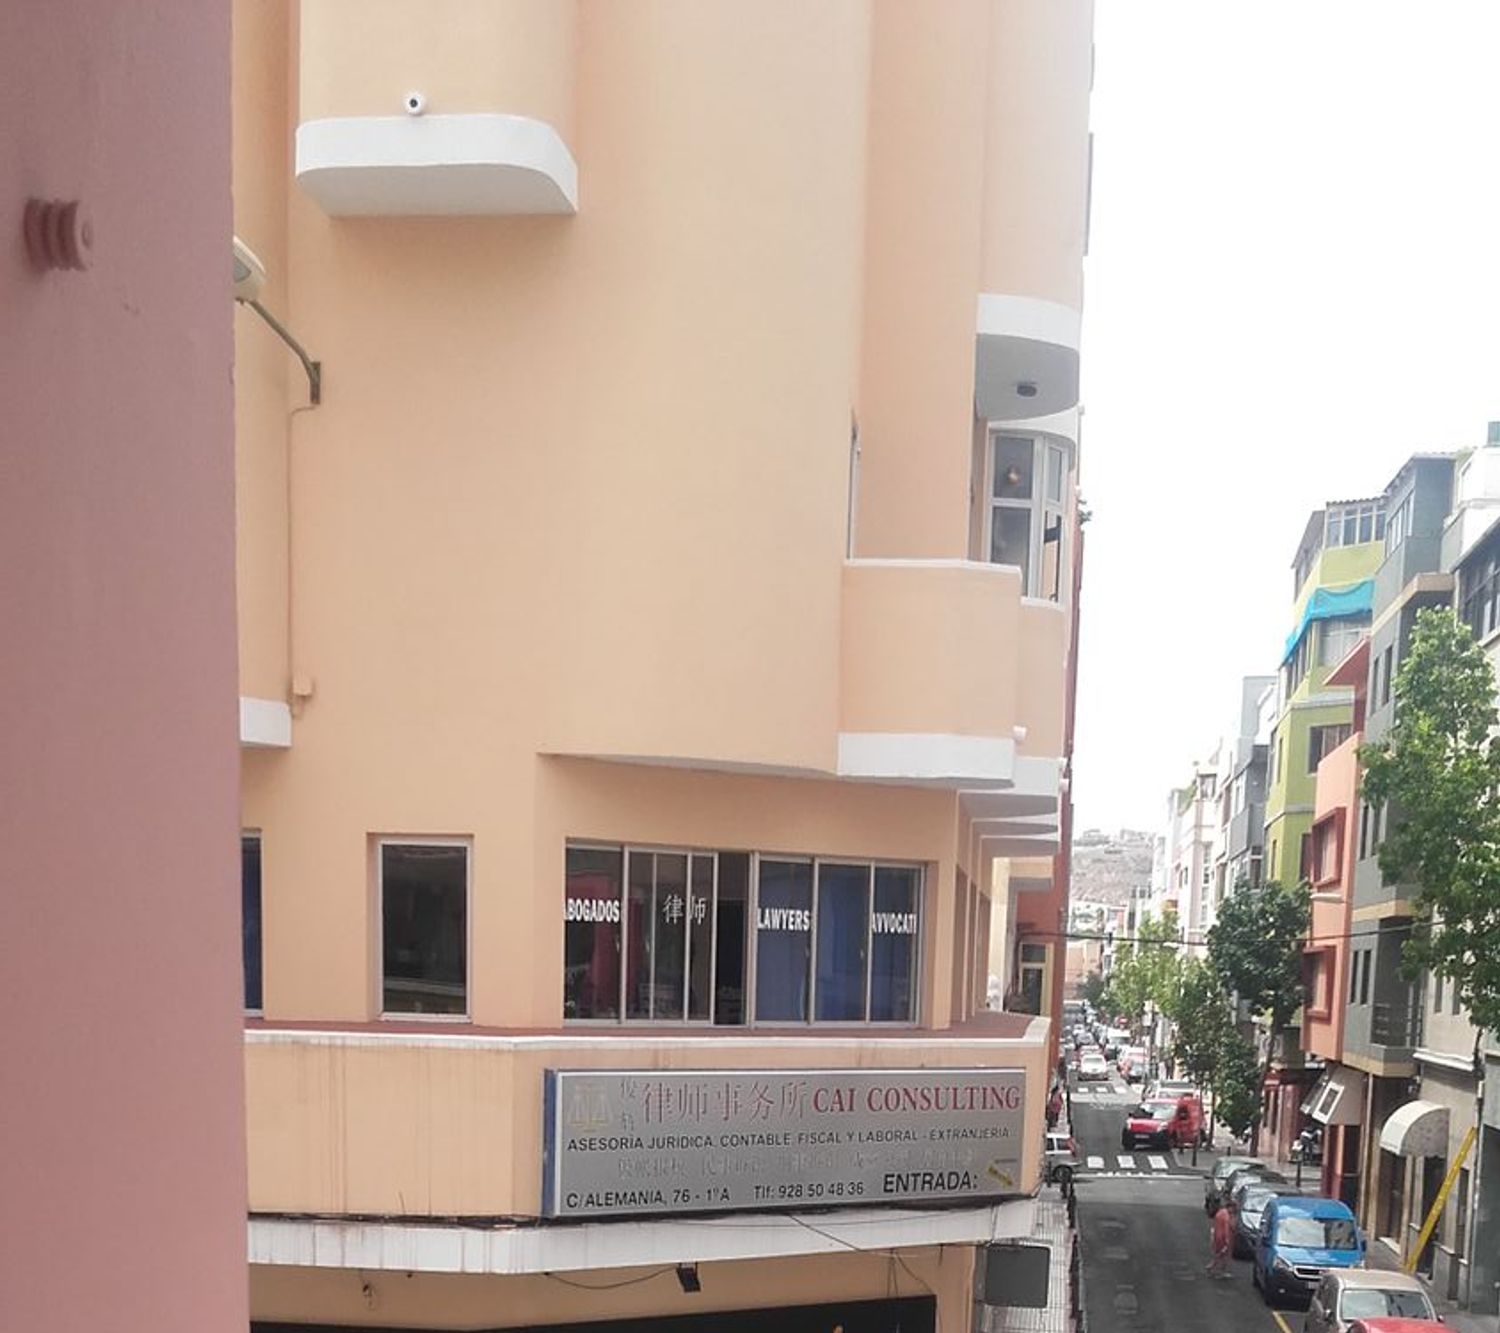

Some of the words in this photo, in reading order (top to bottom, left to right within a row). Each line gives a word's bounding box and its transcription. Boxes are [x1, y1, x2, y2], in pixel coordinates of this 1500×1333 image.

[662, 893, 707, 925] 律师
[757, 909, 810, 932] LAWYERS
[813, 1087, 855, 1112] CAI
[867, 1085, 1021, 1112] CONSULTING
[798, 1131, 842, 1144] FISCAL
[847, 1131, 855, 1142] Y
[858, 1129, 918, 1143] LABORAL
[672, 1189, 691, 1203] 76
[778, 1184, 803, 1199] 928
[807, 1183, 824, 1198] 50
[828, 1182, 845, 1197] 48
[847, 1181, 865, 1196] 36
[883, 1170, 979, 1194] ENTRADA:
